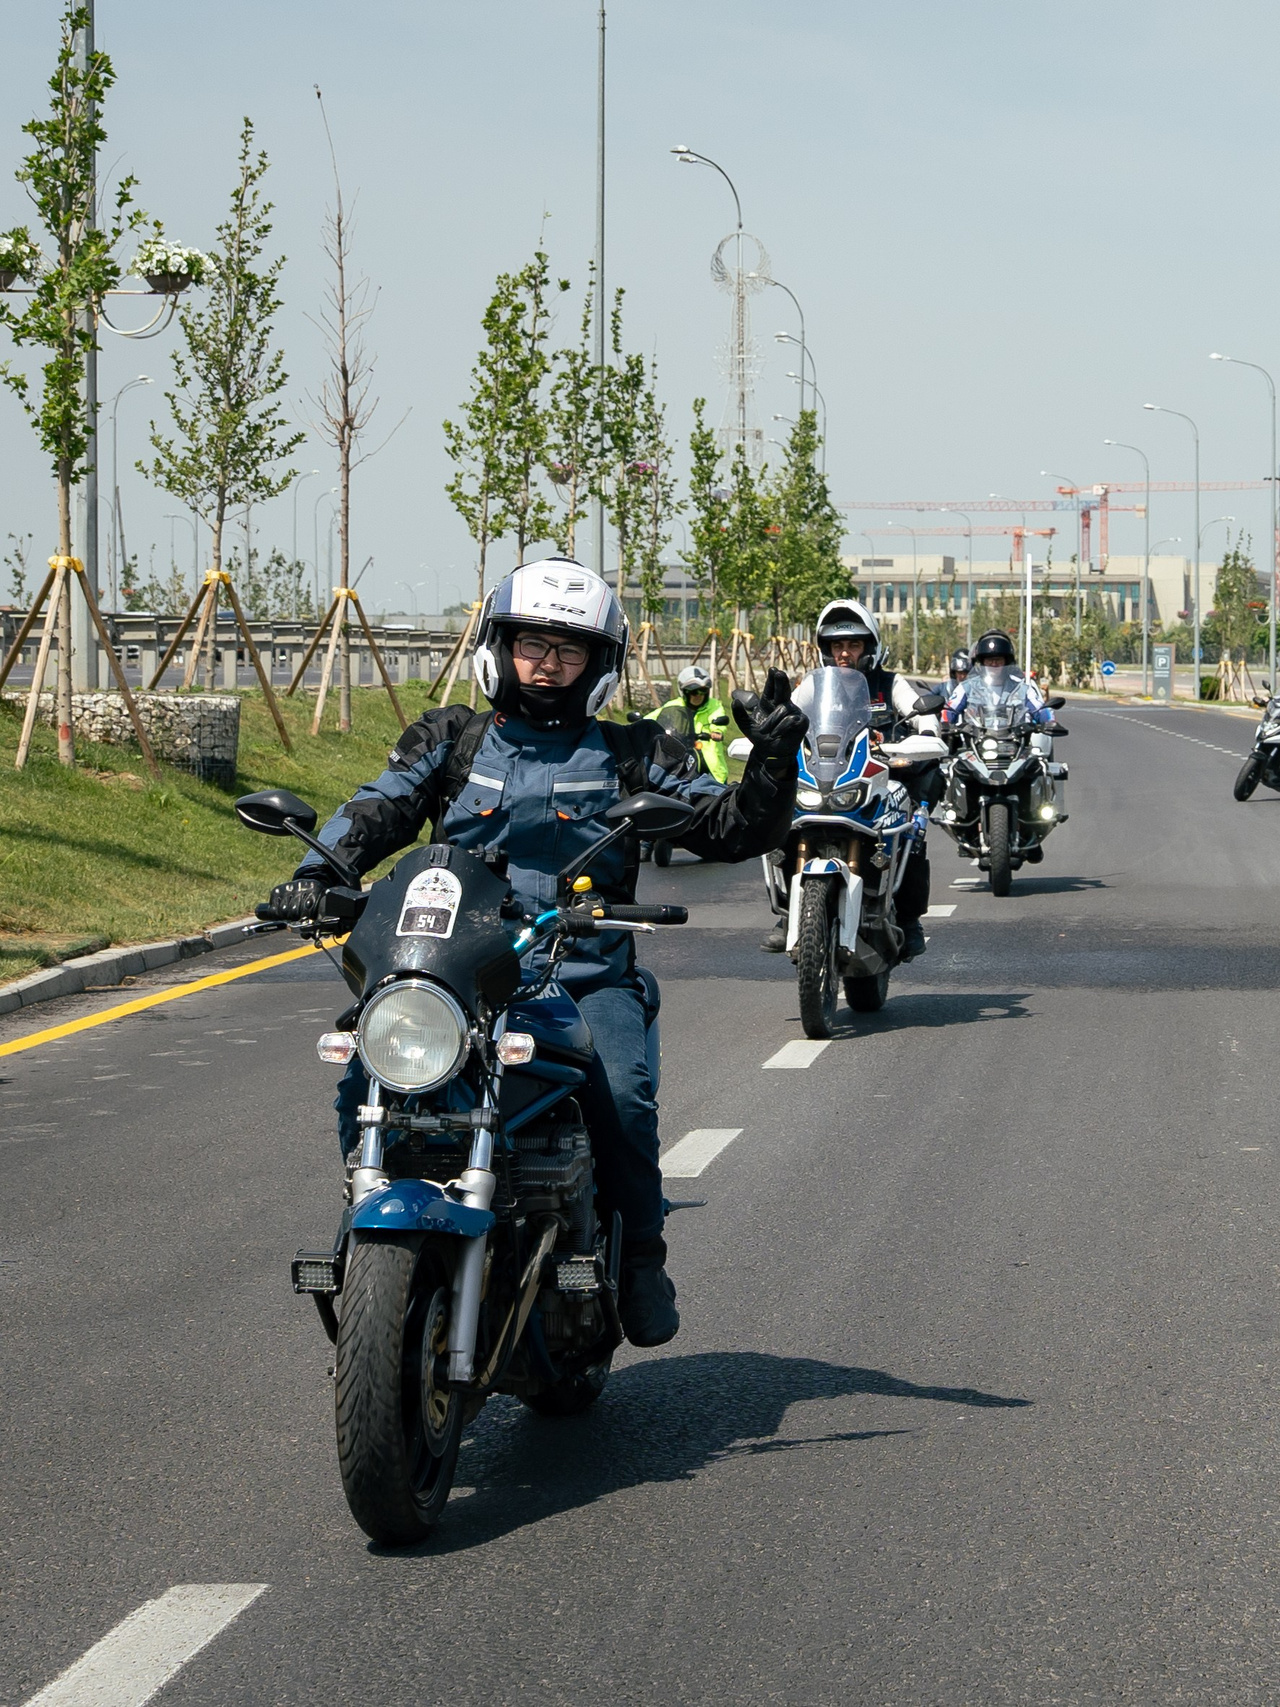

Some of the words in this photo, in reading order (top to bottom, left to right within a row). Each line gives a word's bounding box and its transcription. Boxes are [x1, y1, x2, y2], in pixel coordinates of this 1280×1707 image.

[533, 602, 586, 617] LS2
[1158, 657, 1167, 667] P
[417, 914, 437, 929] 54
